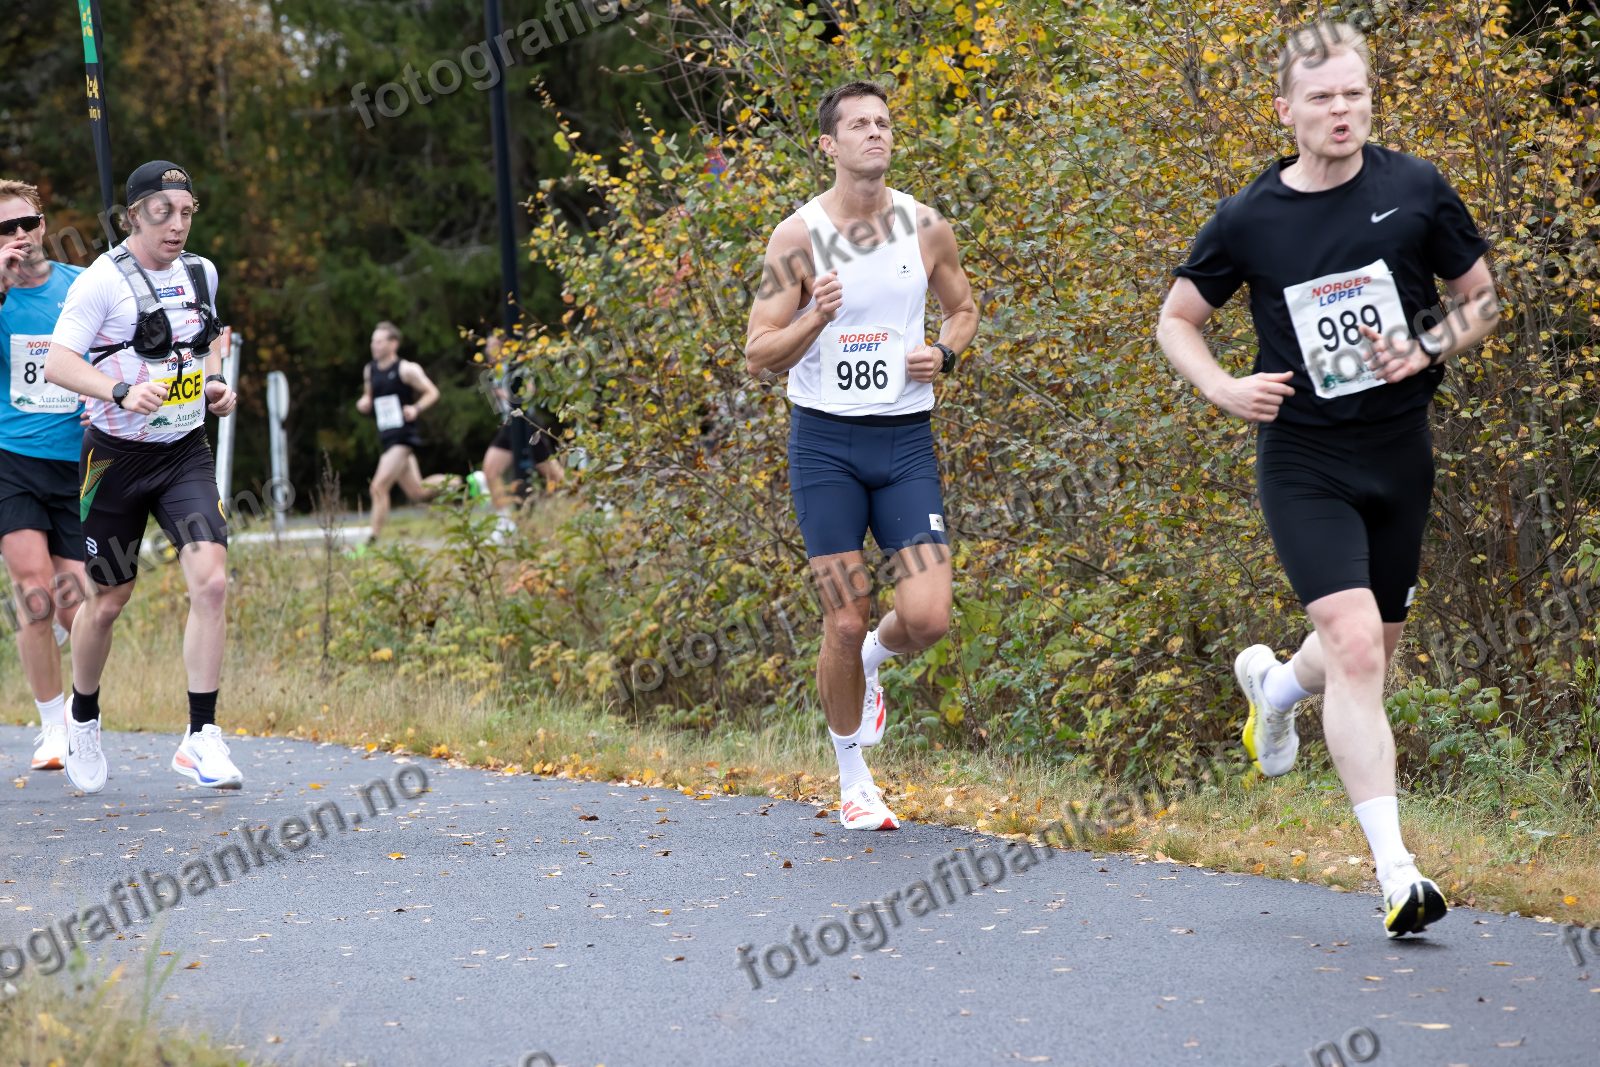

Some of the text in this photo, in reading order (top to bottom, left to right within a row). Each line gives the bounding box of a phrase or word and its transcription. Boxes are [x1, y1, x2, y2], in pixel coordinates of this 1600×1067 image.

[1312, 276, 1372, 300] NORGES
[1319, 286, 1364, 307] LØPET
[838, 332, 888, 344] NORGES
[1317, 304, 1382, 352] 989
[843, 342, 881, 353] LØPET
[161, 373, 201, 402] ACE
[836, 360, 888, 391] 986
